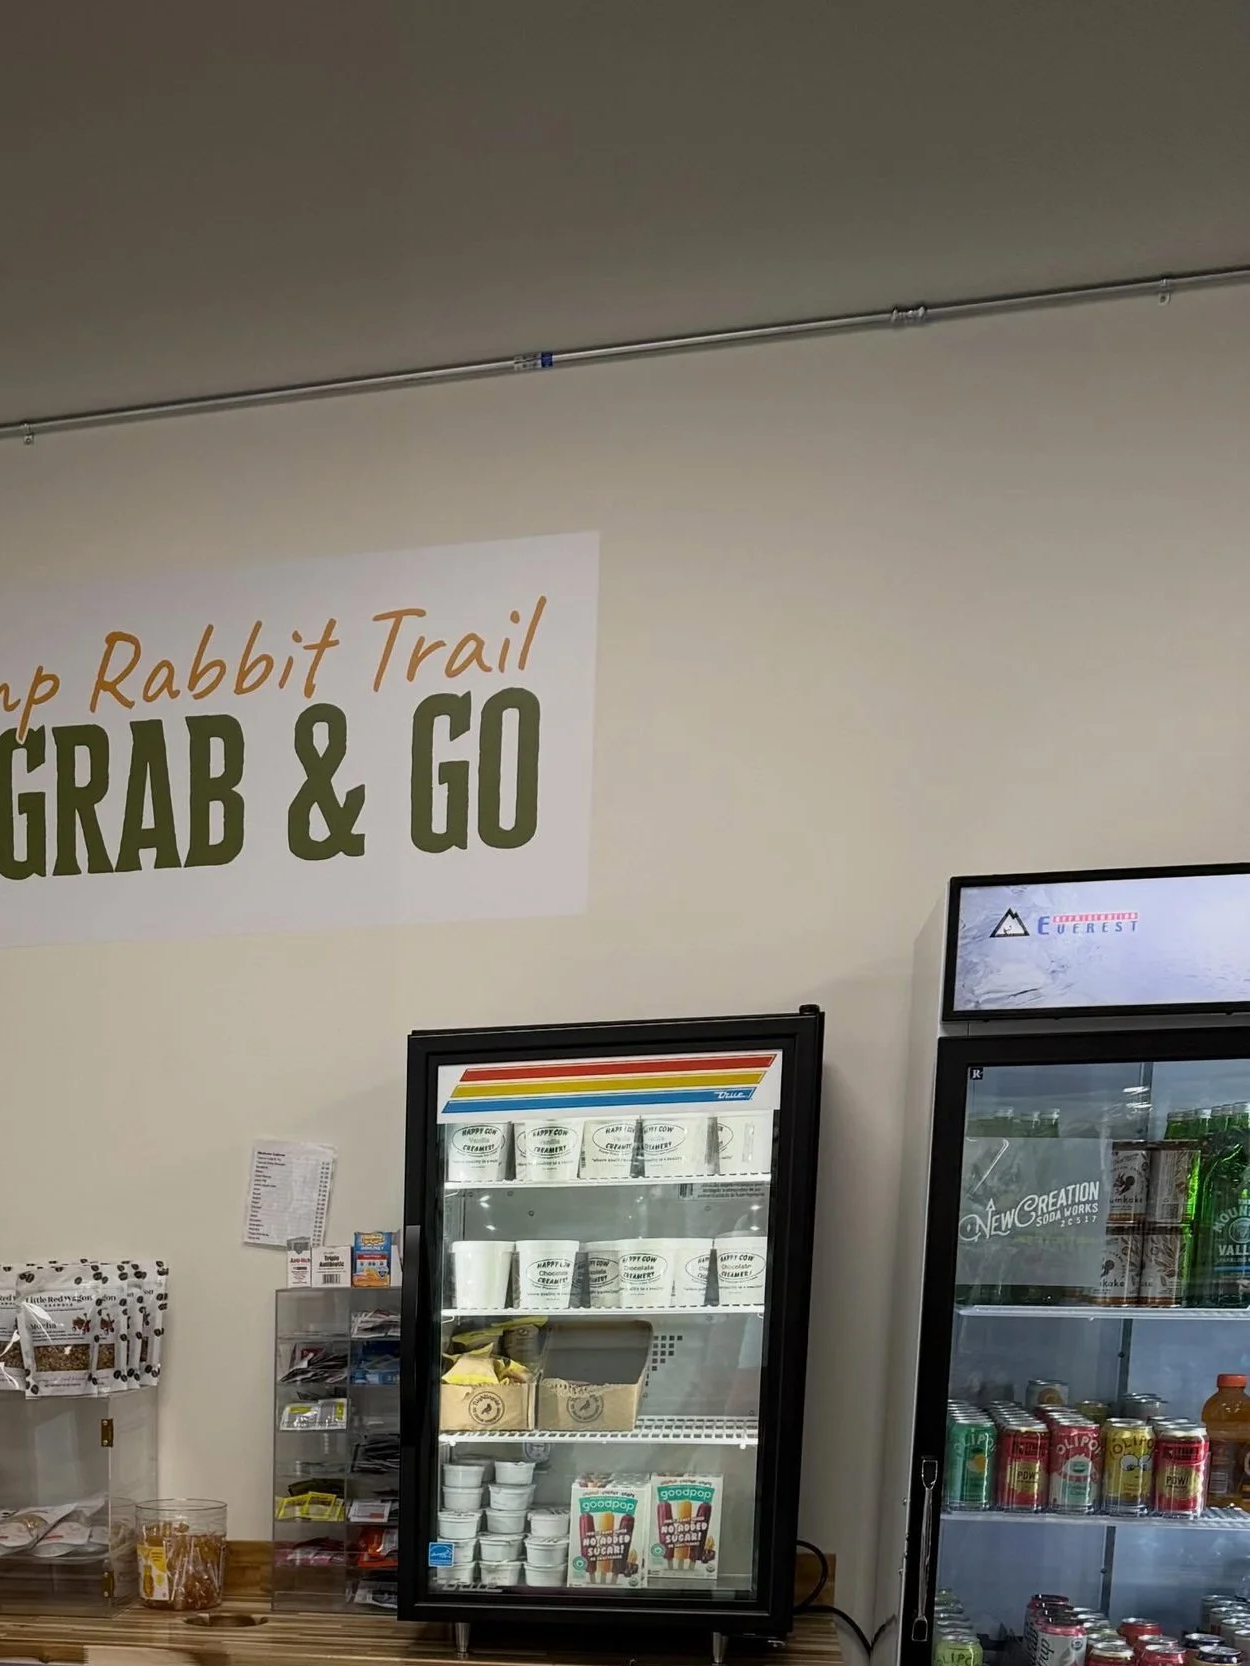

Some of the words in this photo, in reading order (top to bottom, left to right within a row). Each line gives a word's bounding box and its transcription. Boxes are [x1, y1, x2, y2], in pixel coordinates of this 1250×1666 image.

[90, 618, 340, 713] Rabbit
[372, 595, 547, 692] Trail
[287, 702, 367, 862] &
[411, 687, 542, 854] GO
[1038, 916, 1138, 935] EVEREST
[1064, 1203, 1099, 1217] WORKS
[1219, 1245, 1250, 1255] VALL
[660, 1488, 712, 1500] goodpop
[582, 1500, 635, 1512] goodpop
[677, 1522, 708, 1531] ADDED
[600, 1535, 630, 1544] ADDED
[665, 1533, 702, 1543] SUGAR!
[587, 1545, 624, 1555] SUGAR!
